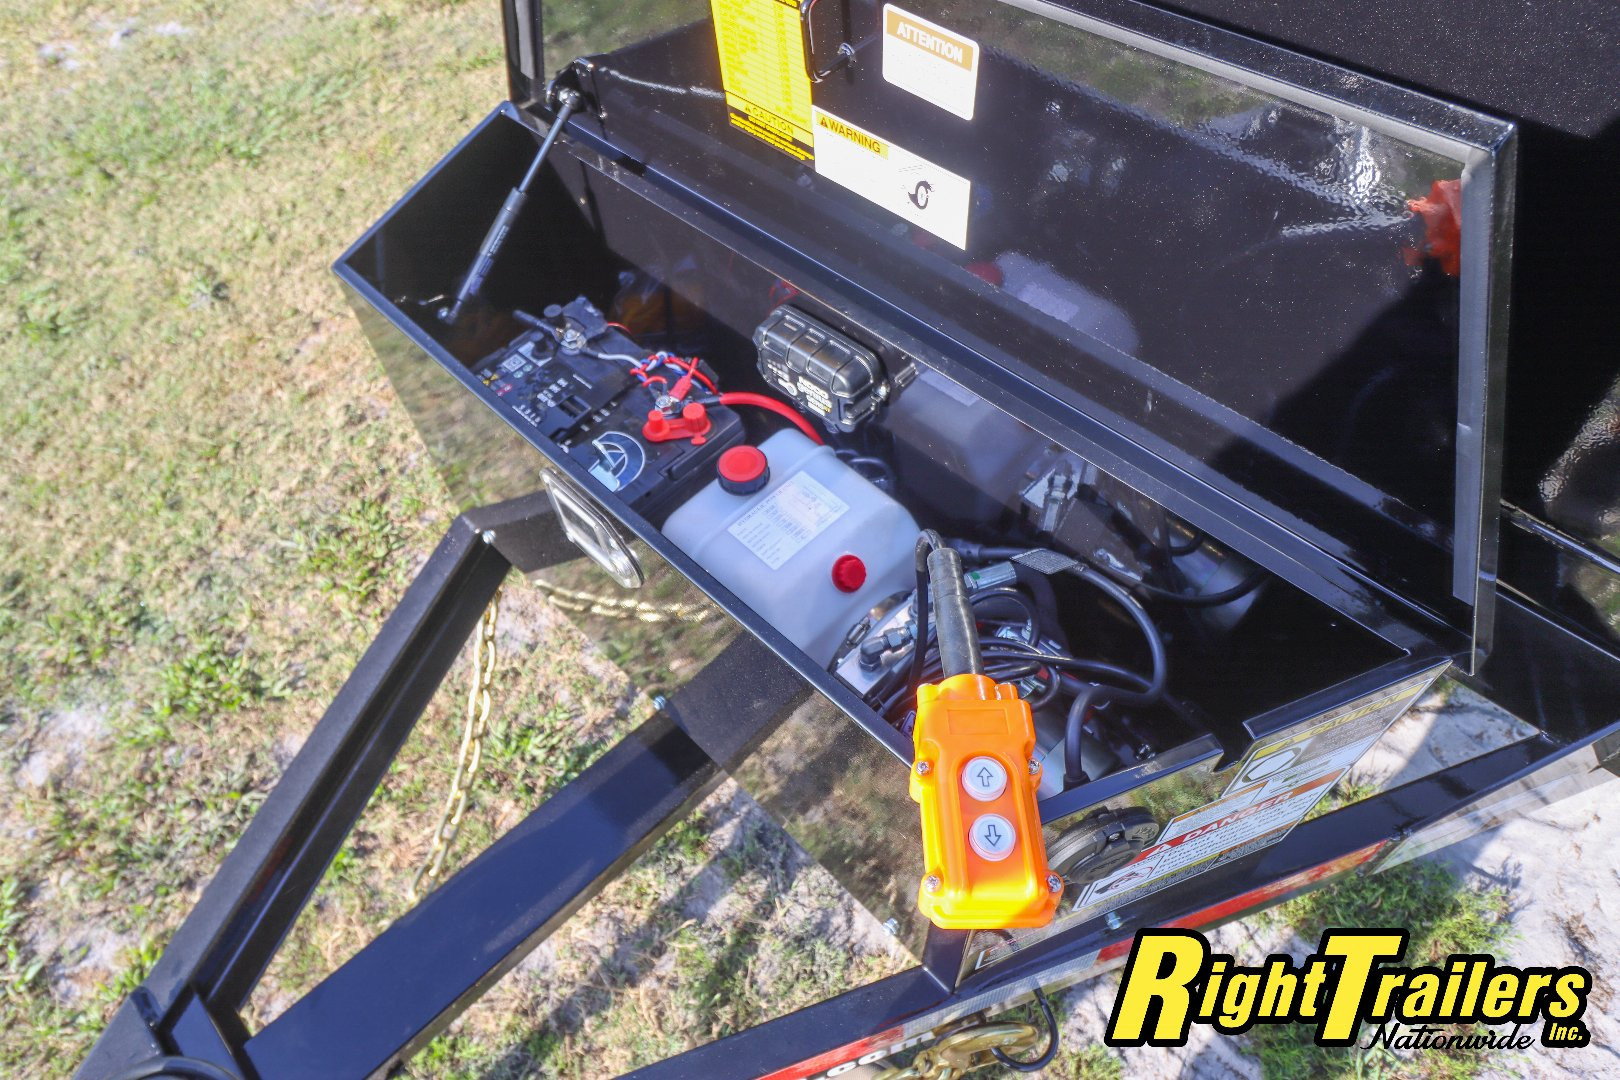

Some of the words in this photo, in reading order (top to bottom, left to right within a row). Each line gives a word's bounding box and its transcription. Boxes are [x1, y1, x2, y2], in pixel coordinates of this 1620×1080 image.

[896, 21, 963, 64] ATTENTION
[752, 106, 795, 135] CAUTION
[827, 122, 882, 154] WARNING
[1309, 694, 1401, 736] CAUTION
[1182, 790, 1295, 843] DANGER
